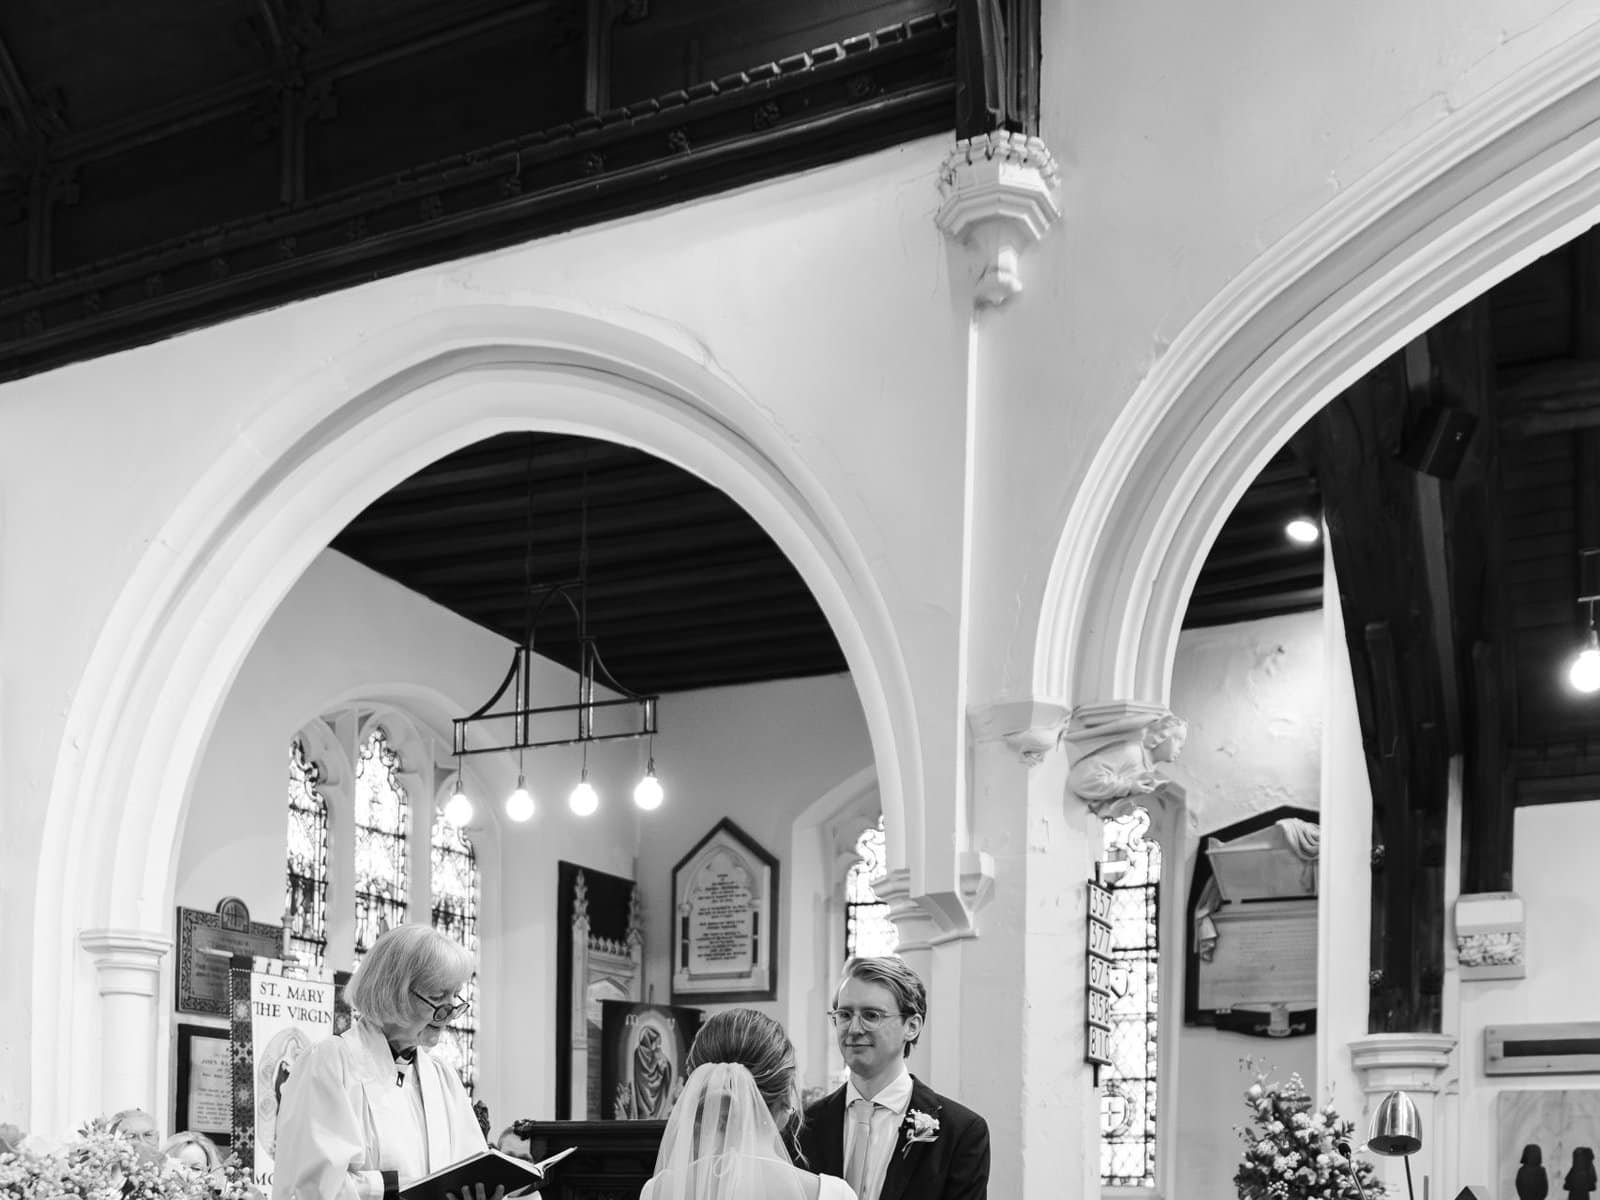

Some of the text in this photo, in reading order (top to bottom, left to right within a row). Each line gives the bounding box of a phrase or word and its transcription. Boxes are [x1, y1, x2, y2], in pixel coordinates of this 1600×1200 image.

[1092, 887, 1112, 919] 357
[1091, 921, 1111, 953] 377
[259, 982, 325, 1003] ST. MARY
[1091, 992, 1110, 1025] 358
[252, 1001, 333, 1025] THE VIRGIN
[1090, 1028, 1111, 1060] 810
